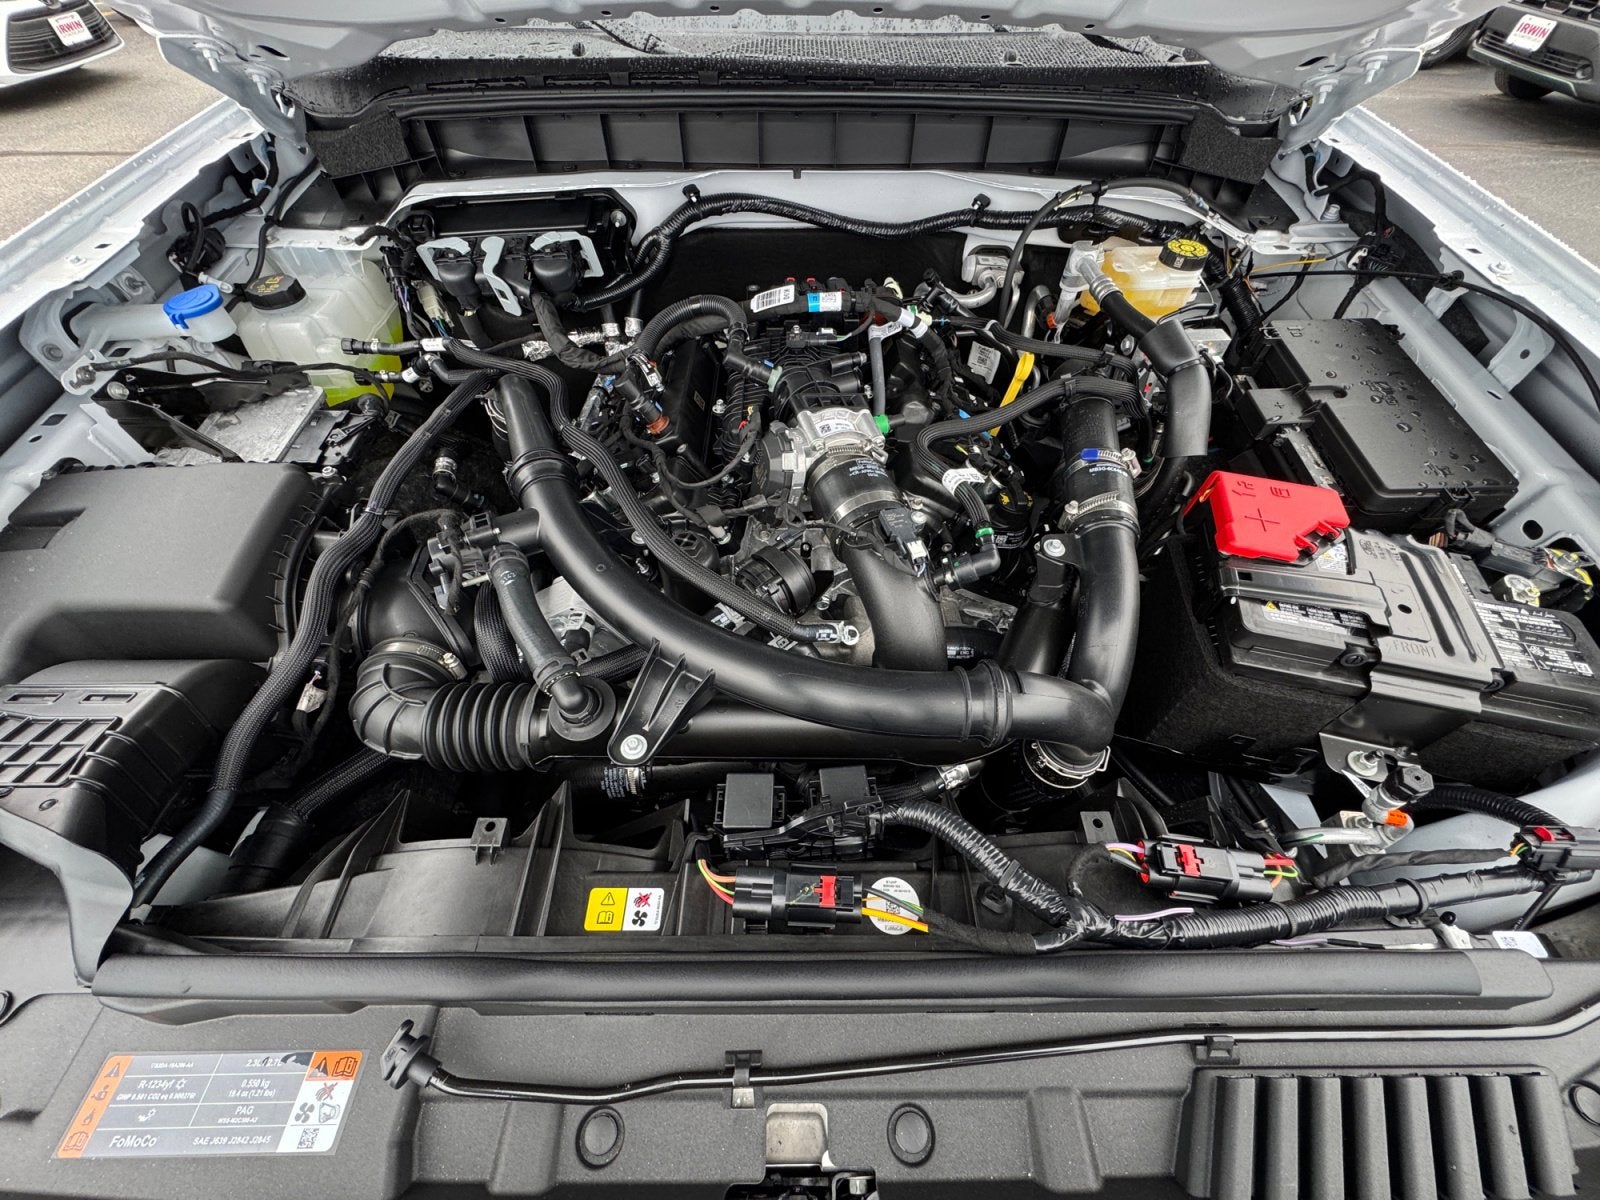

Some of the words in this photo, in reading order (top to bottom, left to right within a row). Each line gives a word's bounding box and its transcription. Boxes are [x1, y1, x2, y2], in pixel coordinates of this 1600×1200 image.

[56, 20, 83, 35] IRWIN
[1516, 22, 1550, 39] IRWIN
[137, 1079, 175, 1091] R-1234yf
[234, 1105, 255, 1115] PAG
[109, 1134, 158, 1148] FoMoCo
[192, 1136, 211, 1145] SAE
